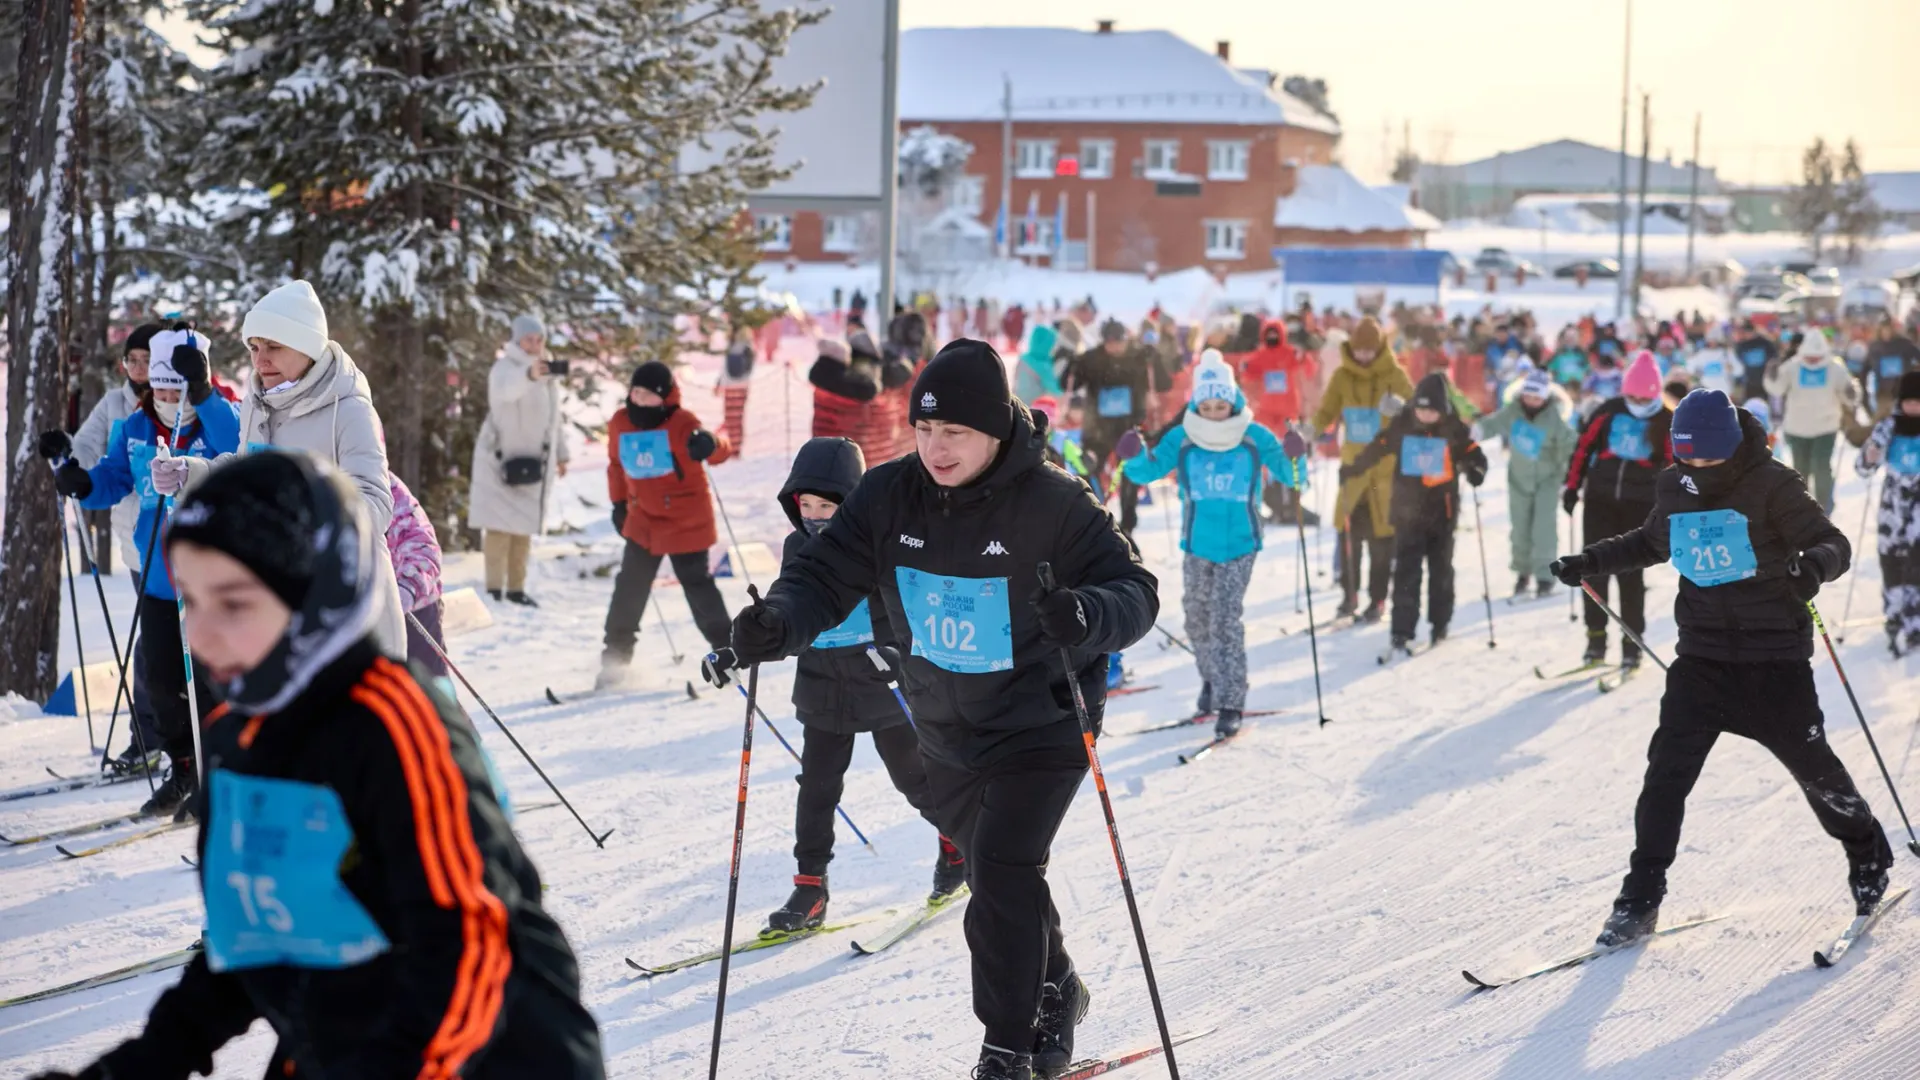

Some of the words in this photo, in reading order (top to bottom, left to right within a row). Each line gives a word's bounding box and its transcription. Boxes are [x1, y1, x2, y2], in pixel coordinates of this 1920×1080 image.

[900, 534, 925, 549] Kappa
[1691, 544, 1733, 571] 213
[924, 613, 978, 652] 102
